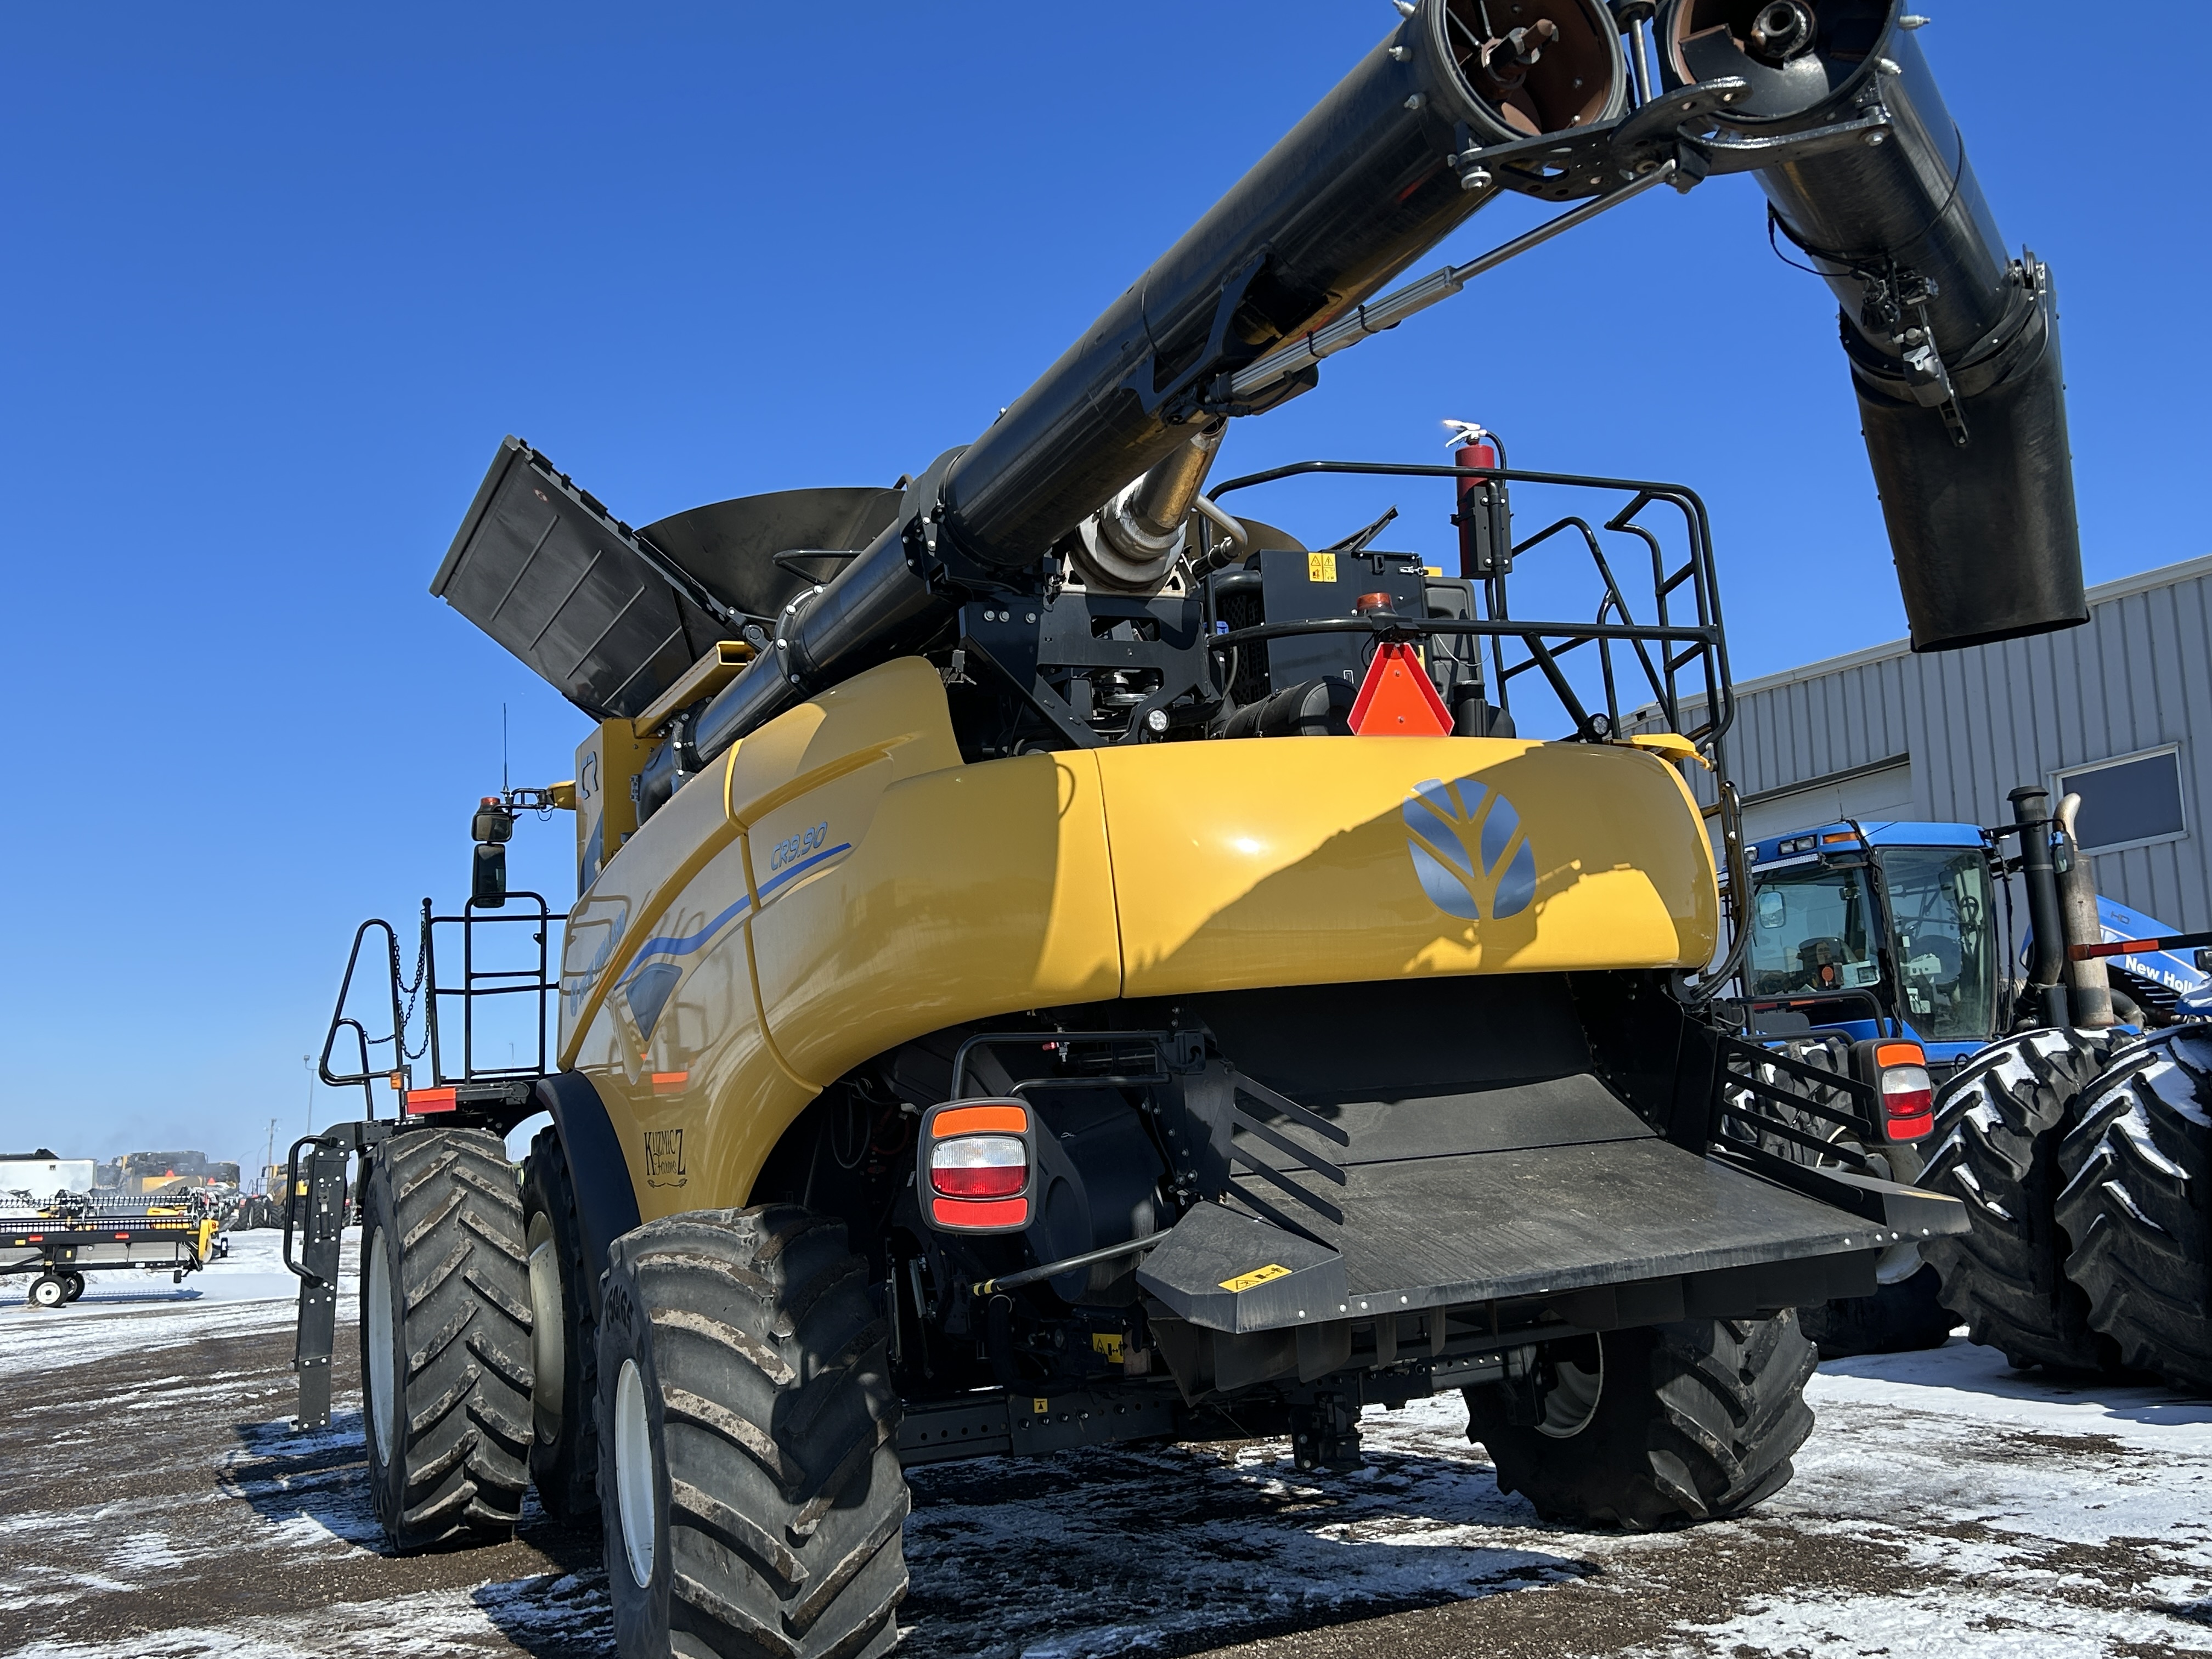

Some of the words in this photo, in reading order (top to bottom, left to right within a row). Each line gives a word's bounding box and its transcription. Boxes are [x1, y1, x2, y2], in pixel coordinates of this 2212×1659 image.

[770, 821, 828, 871] CR9.90
[2110, 911, 2130, 925] HD
[2125, 955, 2160, 980] New
[652, 1152, 677, 1176] Farms
